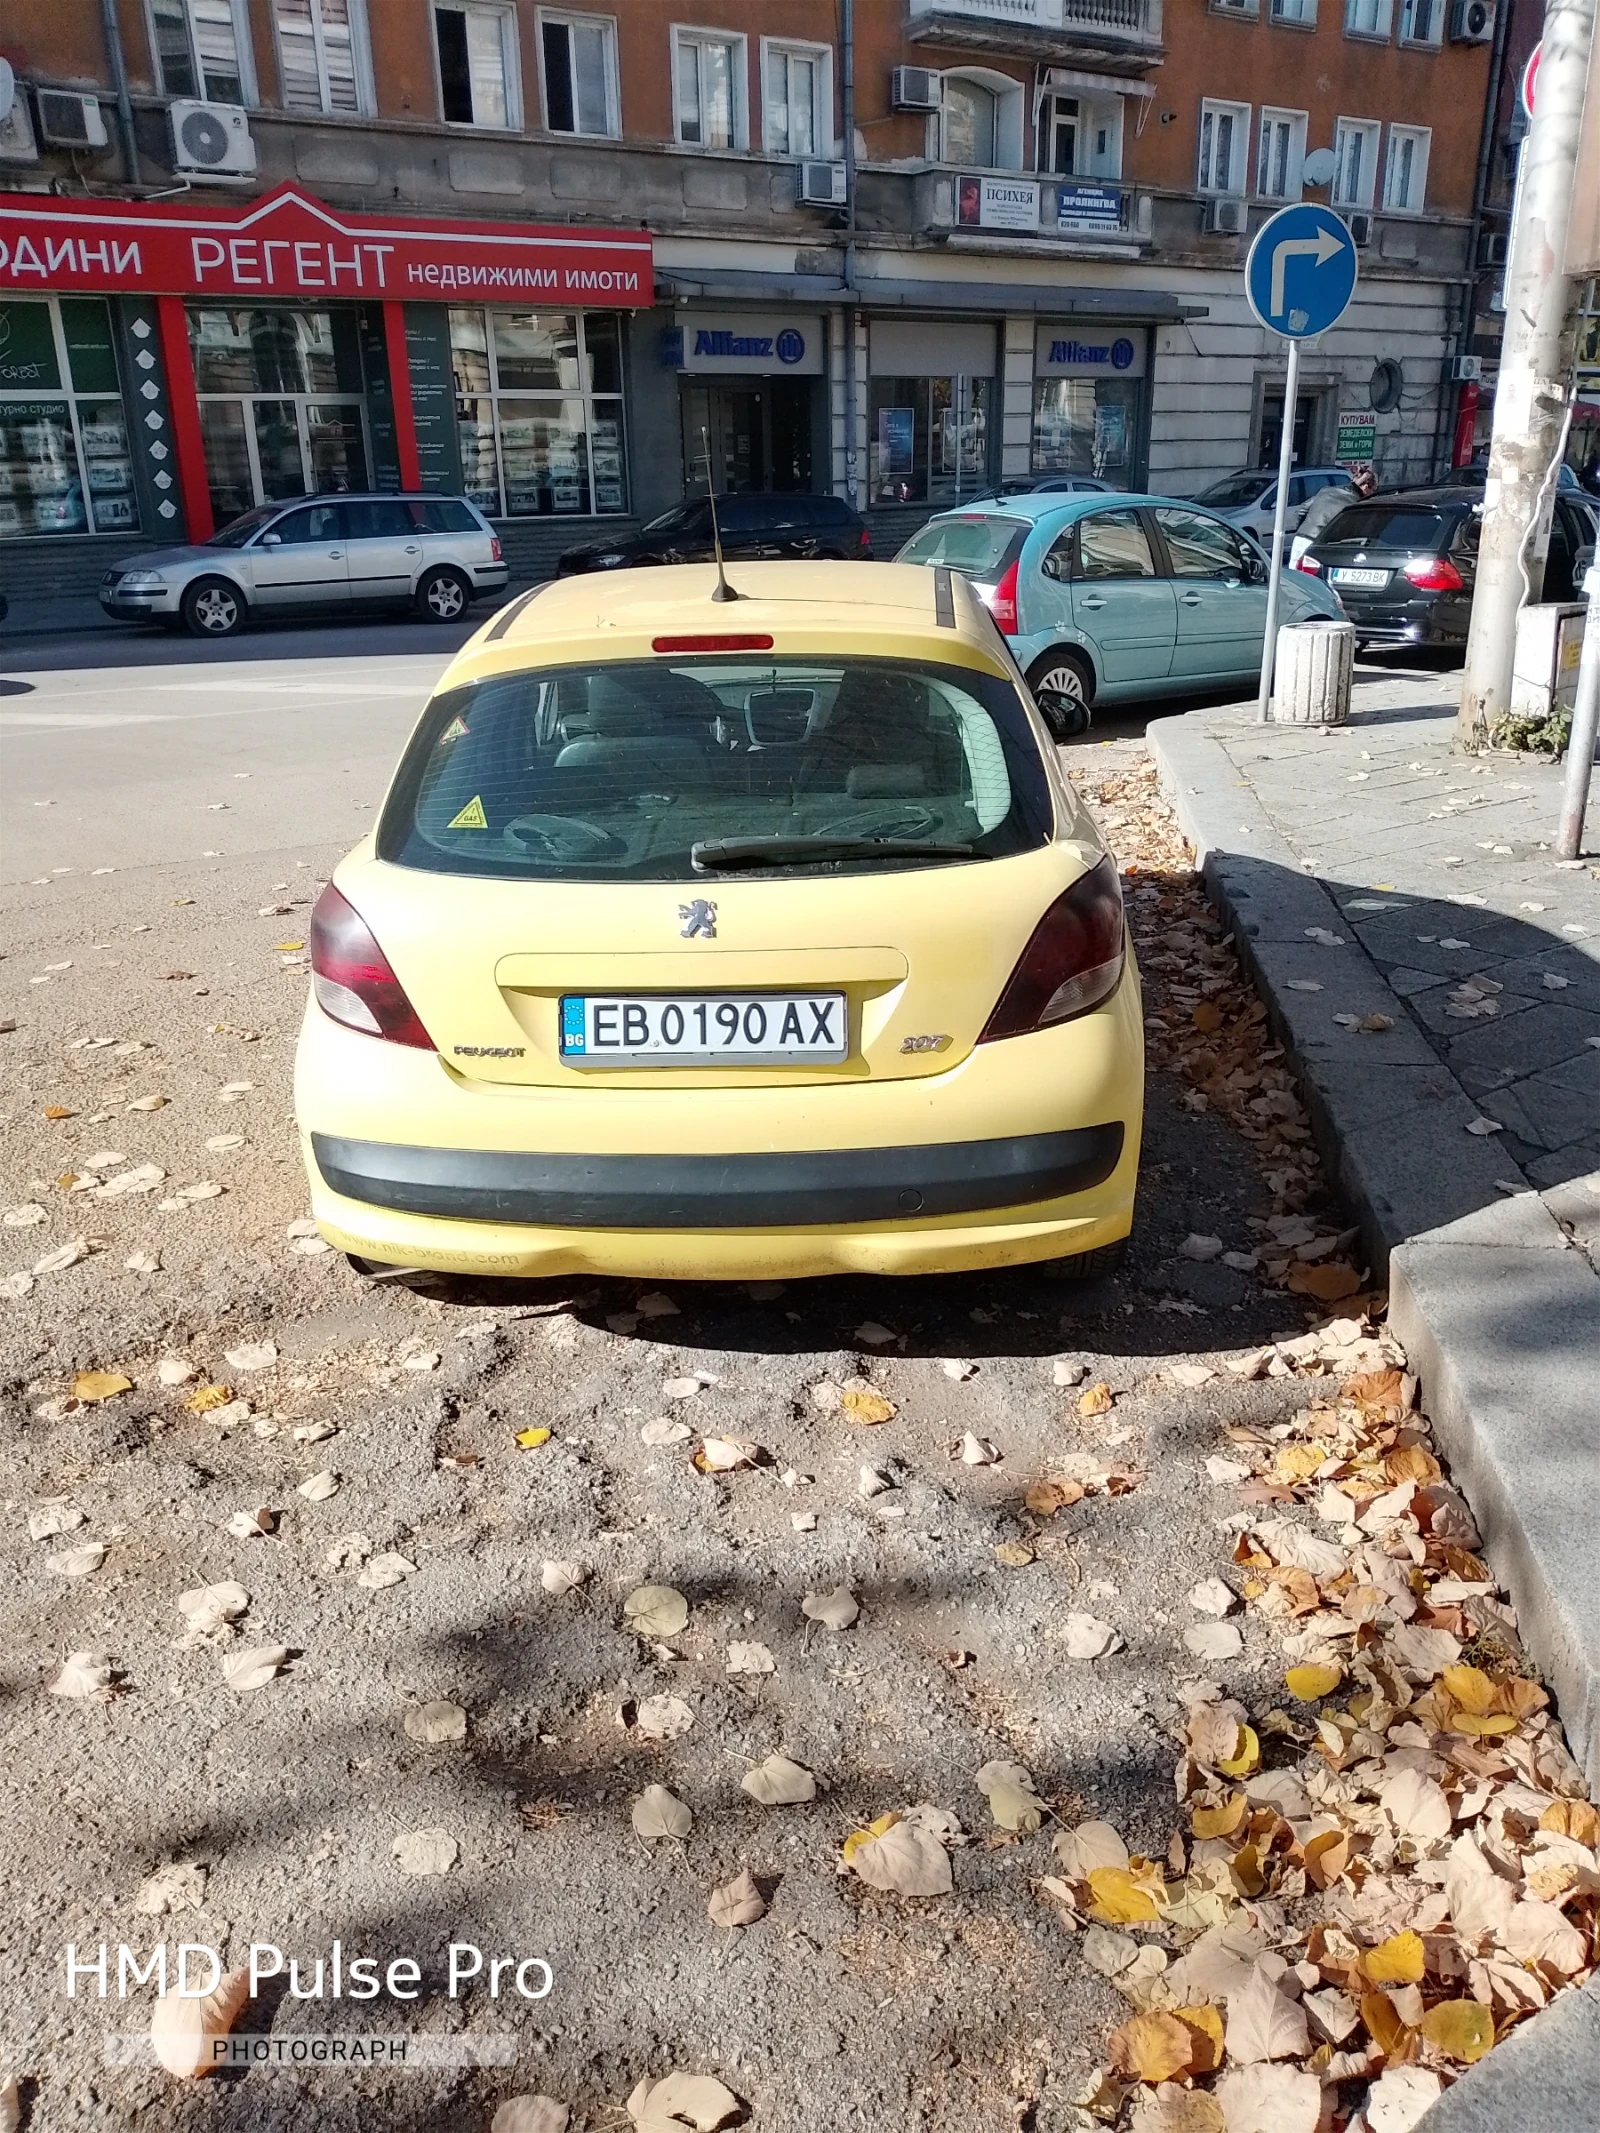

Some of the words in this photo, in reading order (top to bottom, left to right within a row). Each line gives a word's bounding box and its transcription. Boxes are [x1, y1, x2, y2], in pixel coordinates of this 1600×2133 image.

[986, 188, 1034, 205] ПСИХЕЯ
[0, 235, 142, 278] ДИНИ
[191, 236, 395, 288] РЕГЕНТ
[407, 262, 558, 290] недвижими
[565, 269, 639, 291] имоти
[694, 330, 774, 356] Allianz
[1049, 340, 1110, 364] Allianz
[29, 405, 65, 415] студио
[1340, 415, 1375, 425] КУПУВАМ
[1340, 428, 1374, 438] ЗЕМЕДЕЛСКИ
[1351, 570, 1372, 582] 5273
[592, 1003, 650, 1048] EB
[659, 1002, 768, 1045] 0190
[778, 1001, 836, 1044] AX
[564, 1033, 585, 1048] BG
[899, 1035, 947, 1054] 207
[453, 1045, 527, 1059] PEUGEOT
